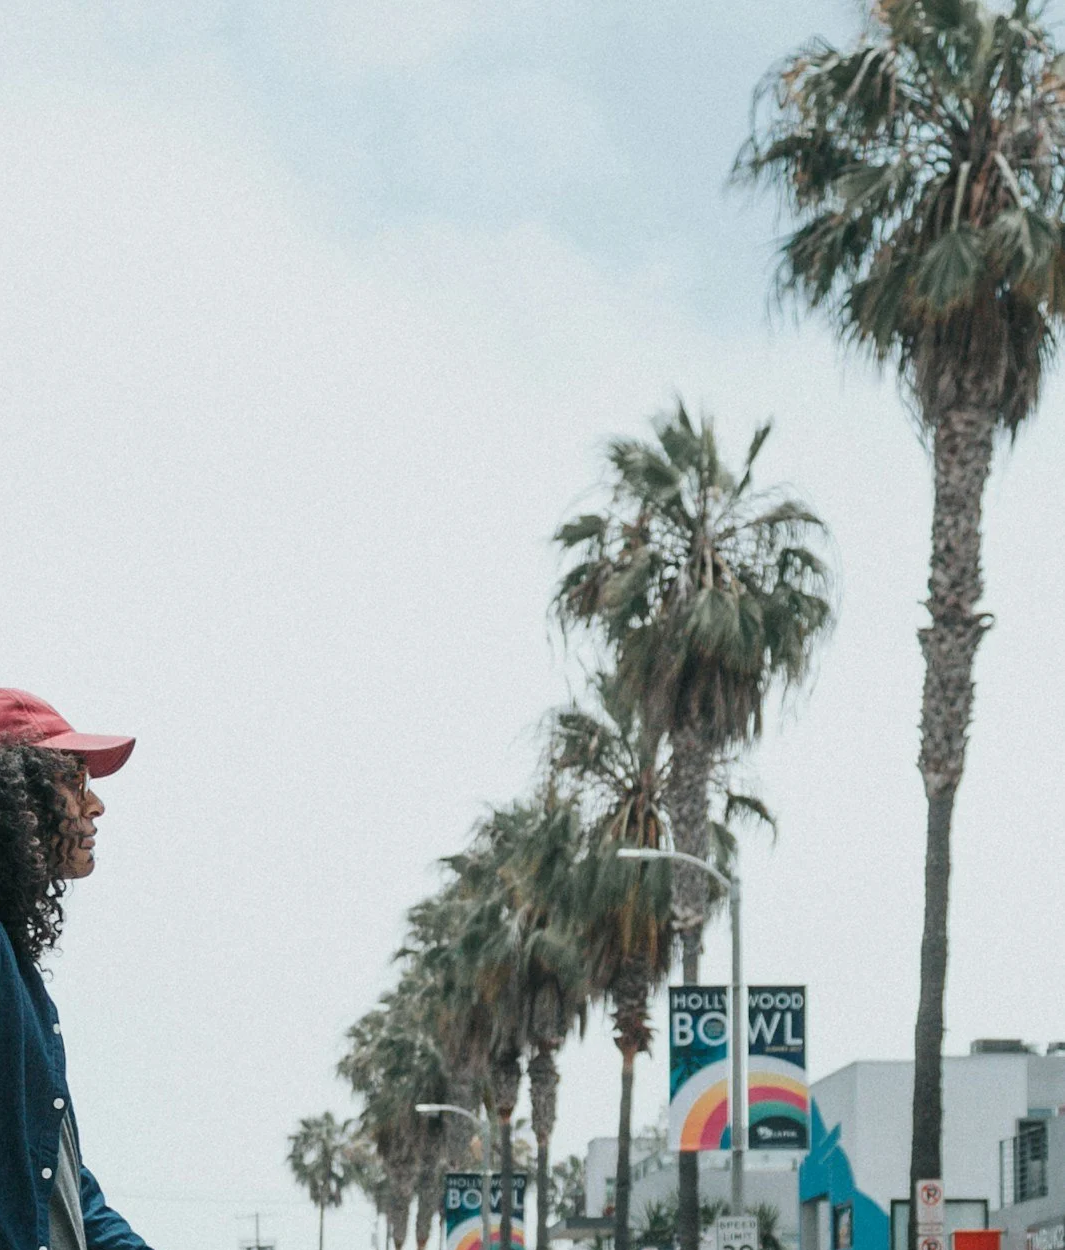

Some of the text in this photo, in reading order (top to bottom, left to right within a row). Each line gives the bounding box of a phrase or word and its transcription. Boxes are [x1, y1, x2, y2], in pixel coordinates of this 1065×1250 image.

[673, 1011, 803, 1046] BOWL
[719, 1221, 756, 1230] SPEED
[723, 1232, 753, 1241] LIMIT
